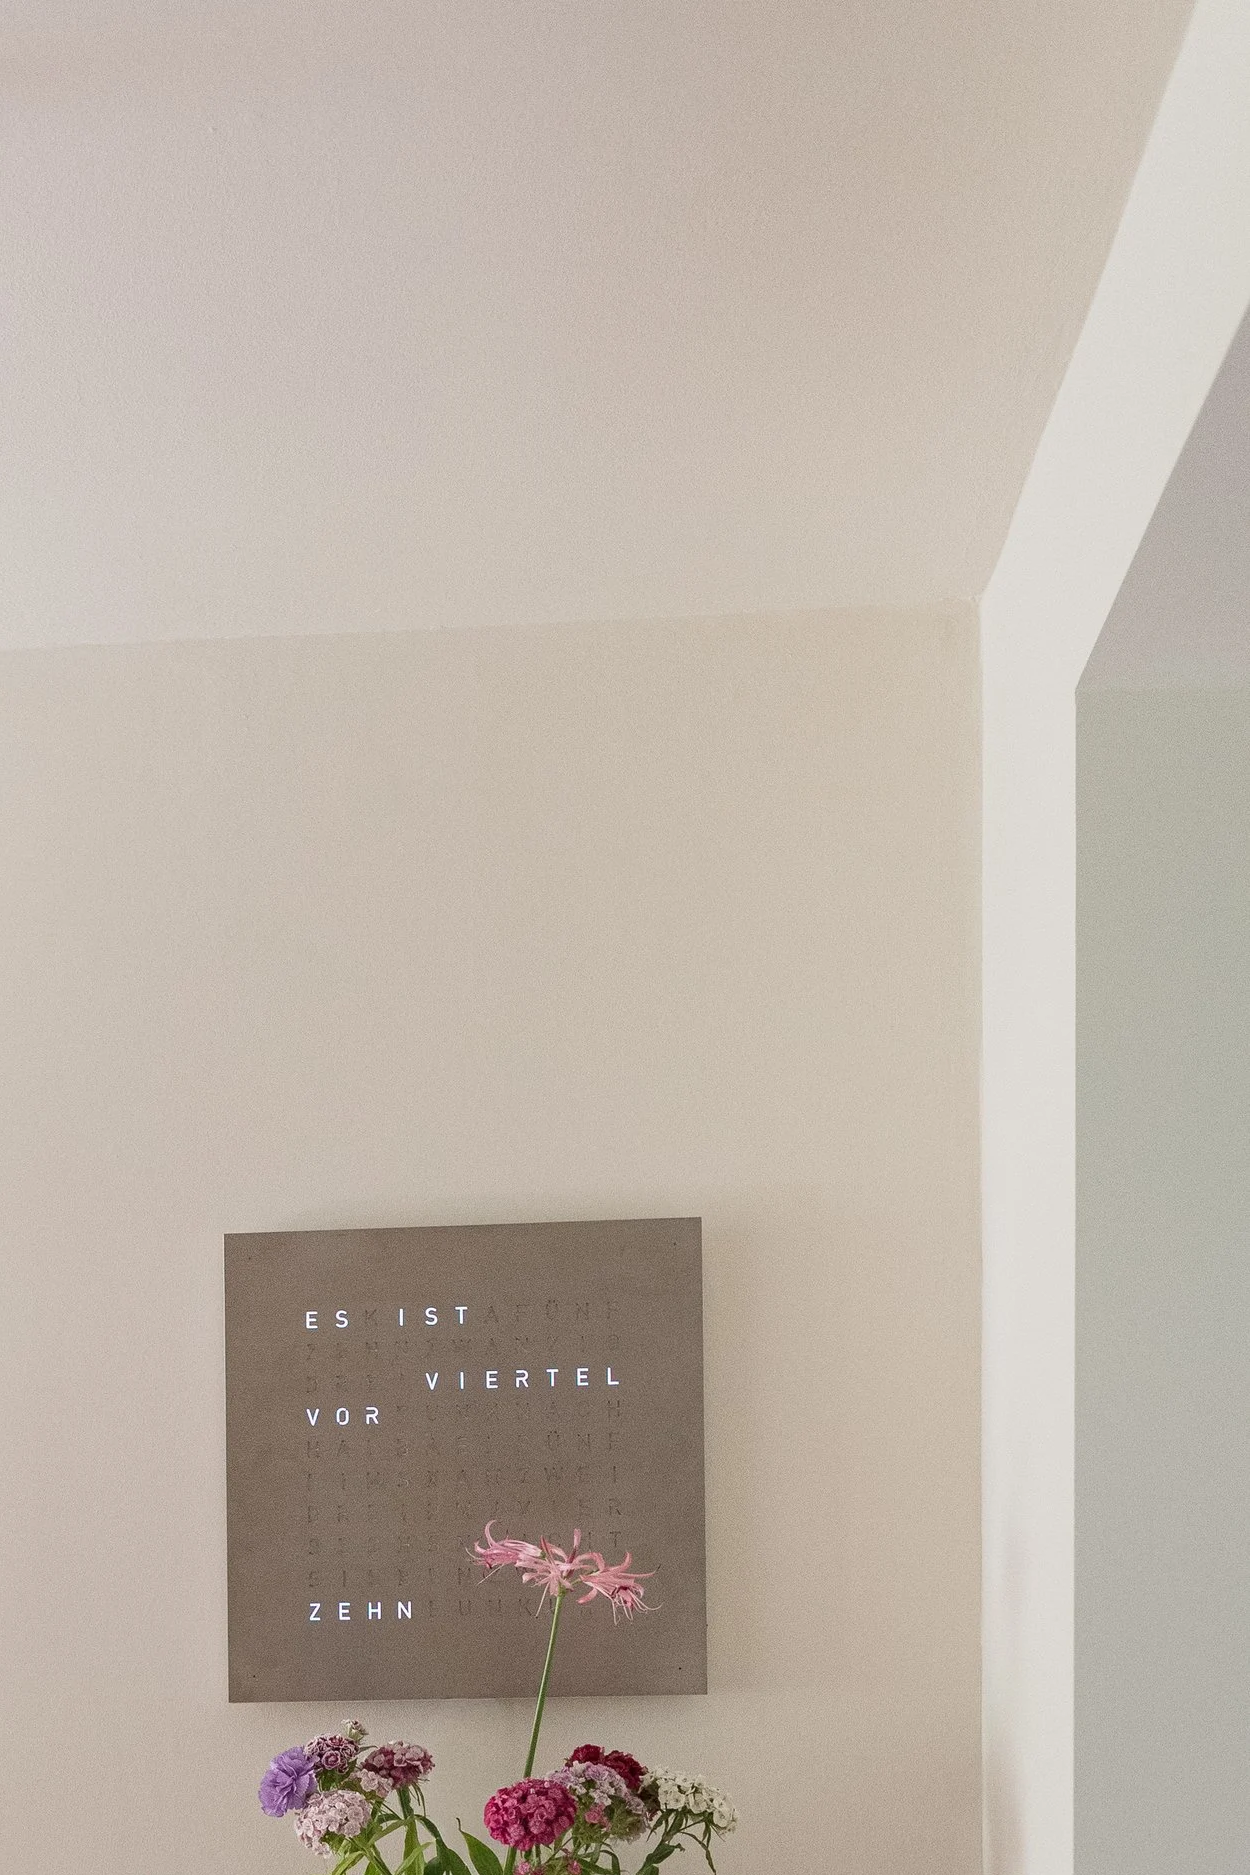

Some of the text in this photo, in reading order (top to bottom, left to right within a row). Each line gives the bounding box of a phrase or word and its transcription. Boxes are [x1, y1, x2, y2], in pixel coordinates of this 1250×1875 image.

[306, 1306, 468, 1329] ES IST
[426, 1367, 619, 1390] VIERTEL
[307, 1407, 379, 1426] VOR
[309, 1601, 412, 1620] ZEHN
